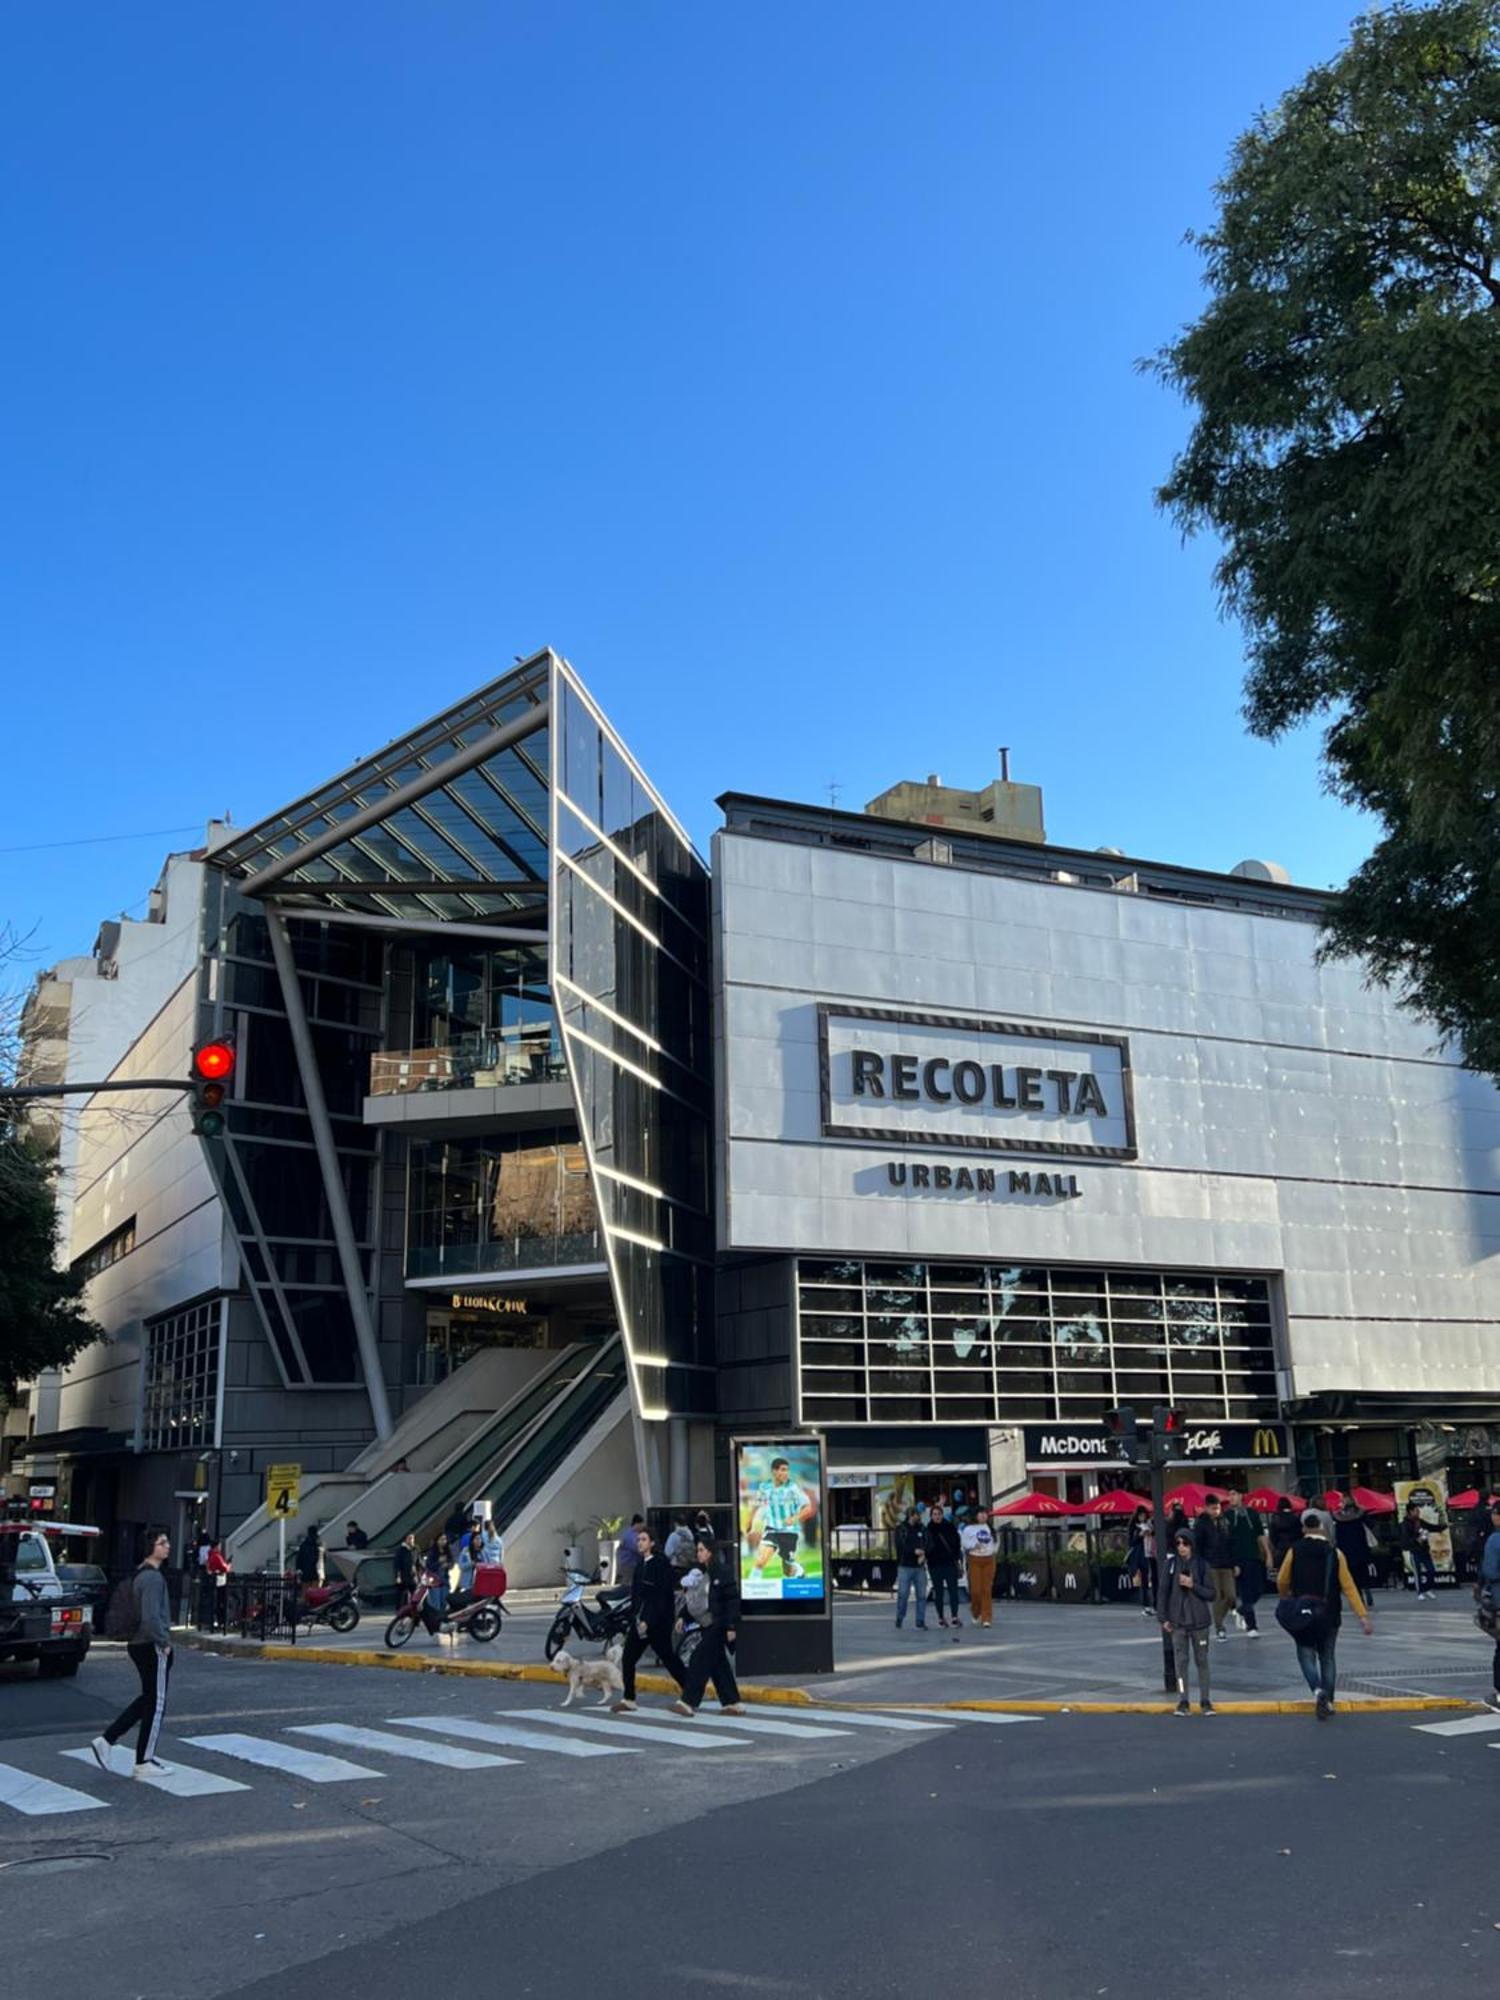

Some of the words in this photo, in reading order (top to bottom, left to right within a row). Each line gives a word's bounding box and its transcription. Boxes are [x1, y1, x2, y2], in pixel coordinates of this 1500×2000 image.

[852, 1050, 1107, 1116] RECOLETA
[888, 1162, 996, 1192] URBAN
[1008, 1171, 1083, 1199] MALL
[275, 1489, 289, 1513] 4
